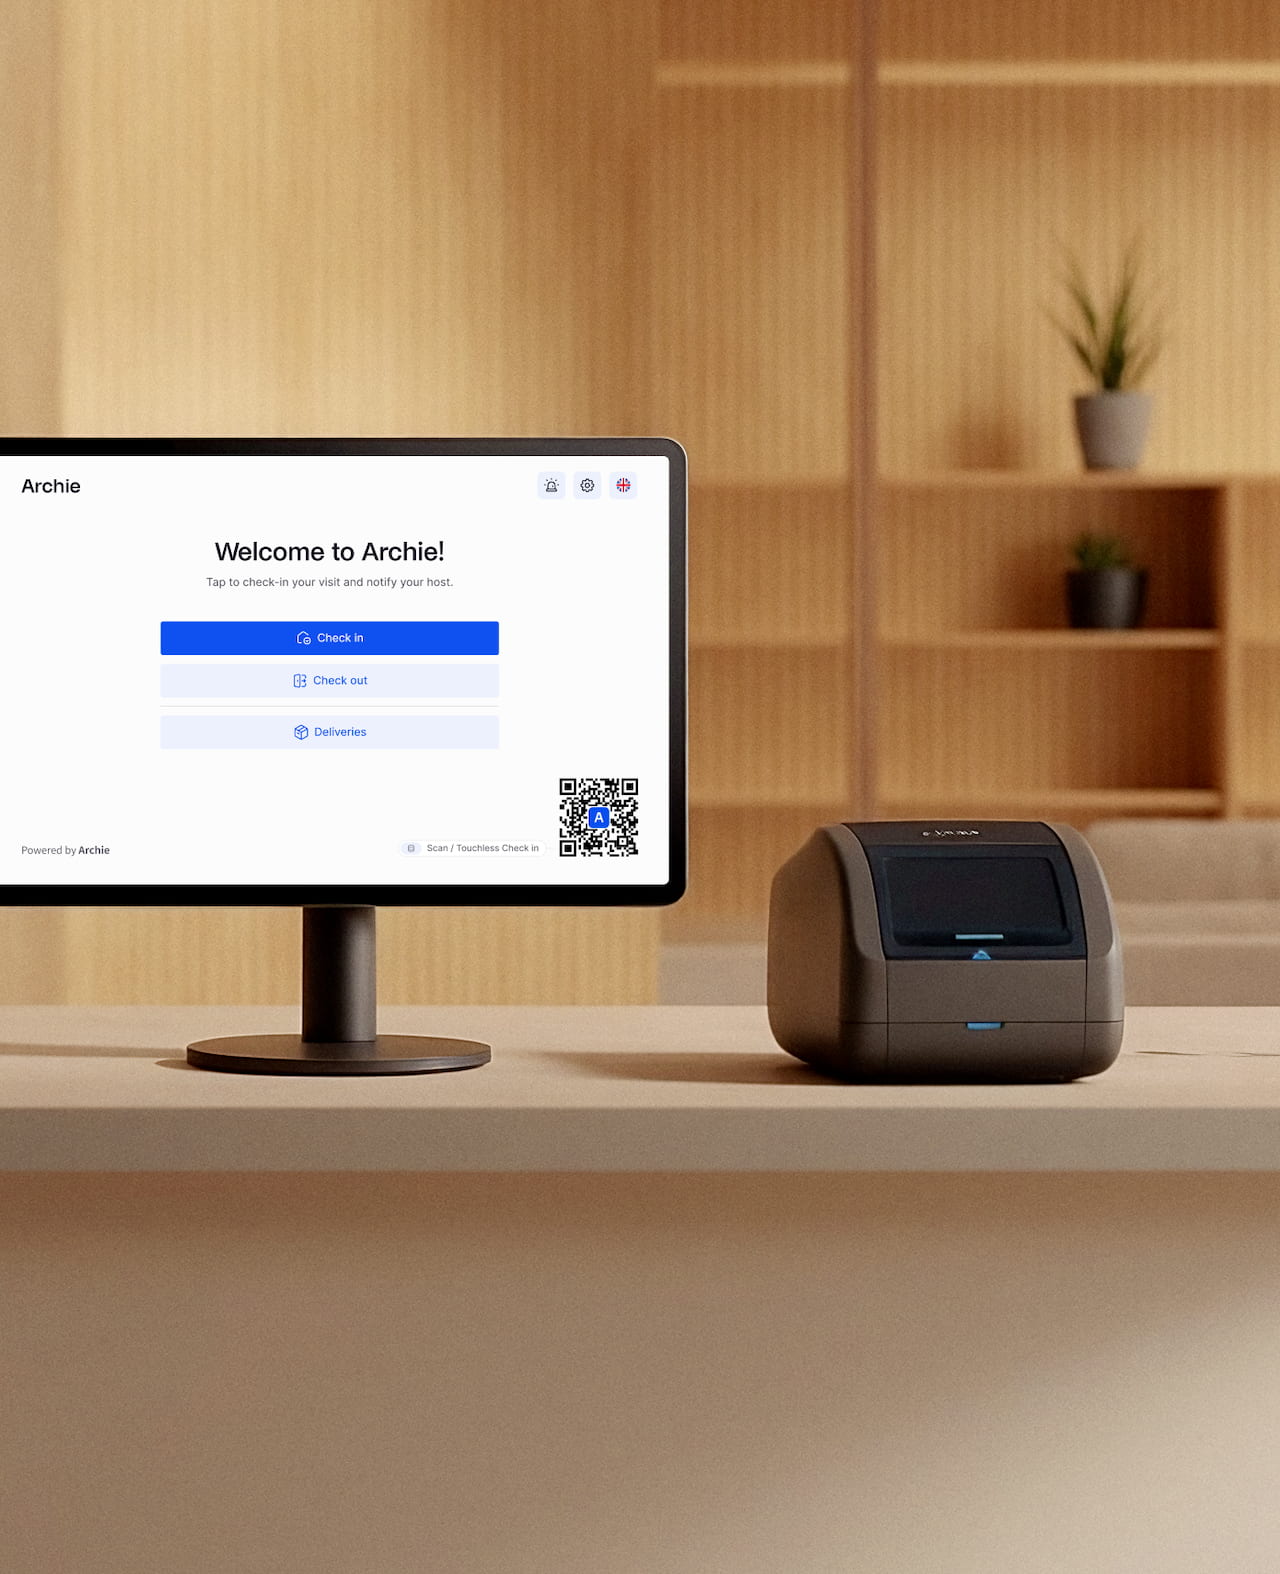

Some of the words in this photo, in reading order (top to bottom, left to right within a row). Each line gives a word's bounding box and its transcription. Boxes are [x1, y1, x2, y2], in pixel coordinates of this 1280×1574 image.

[21, 478, 81, 493] Archie
[215, 540, 325, 562] Welcome
[331, 543, 355, 562] to
[361, 540, 444, 562] Archie!
[206, 577, 226, 590] Tap
[229, 578, 239, 587] to
[243, 577, 288, 587] check-in
[292, 579, 315, 590] your
[318, 577, 340, 587] visit
[344, 577, 363, 587] and
[367, 577, 397, 590] notify
[400, 579, 424, 590] your
[427, 577, 453, 587] host.
[317, 632, 350, 643] Check
[353, 632, 364, 643] in
[313, 675, 347, 686] Check
[350, 676, 368, 686] out
[314, 726, 367, 737] Deliveries
[594, 811, 604, 823] A
[21, 845, 62, 855] Powered
[65, 845, 77, 857] by
[78, 845, 110, 855] Archie
[427, 843, 449, 852] Scan
[450, 843, 455, 852] /
[457, 843, 499, 852] Touchless
[502, 843, 529, 852] Check
[531, 843, 539, 852] in
